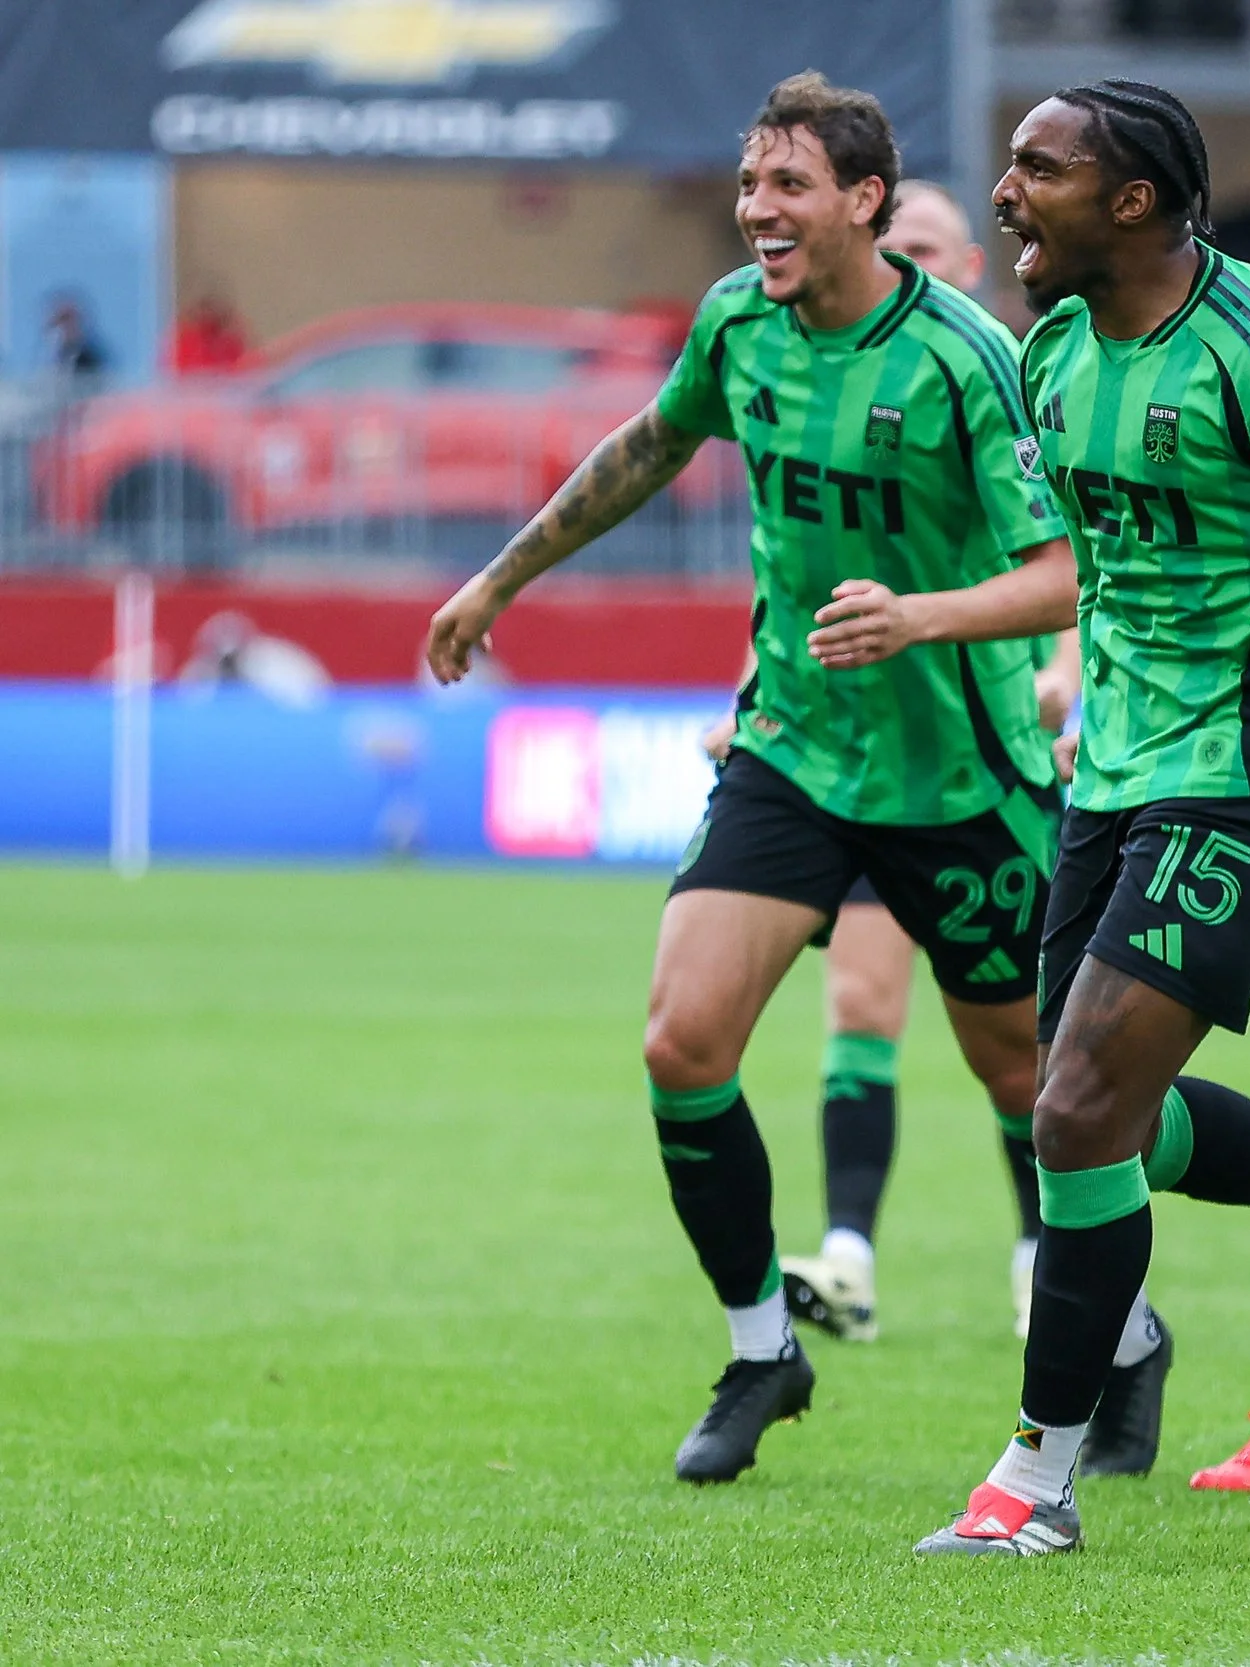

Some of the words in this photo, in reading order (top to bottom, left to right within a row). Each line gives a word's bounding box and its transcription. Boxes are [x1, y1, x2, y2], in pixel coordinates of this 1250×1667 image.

[1149, 407, 1177, 420] AUSTIN
[744, 443, 904, 534] YETI
[934, 855, 1037, 943] 29
